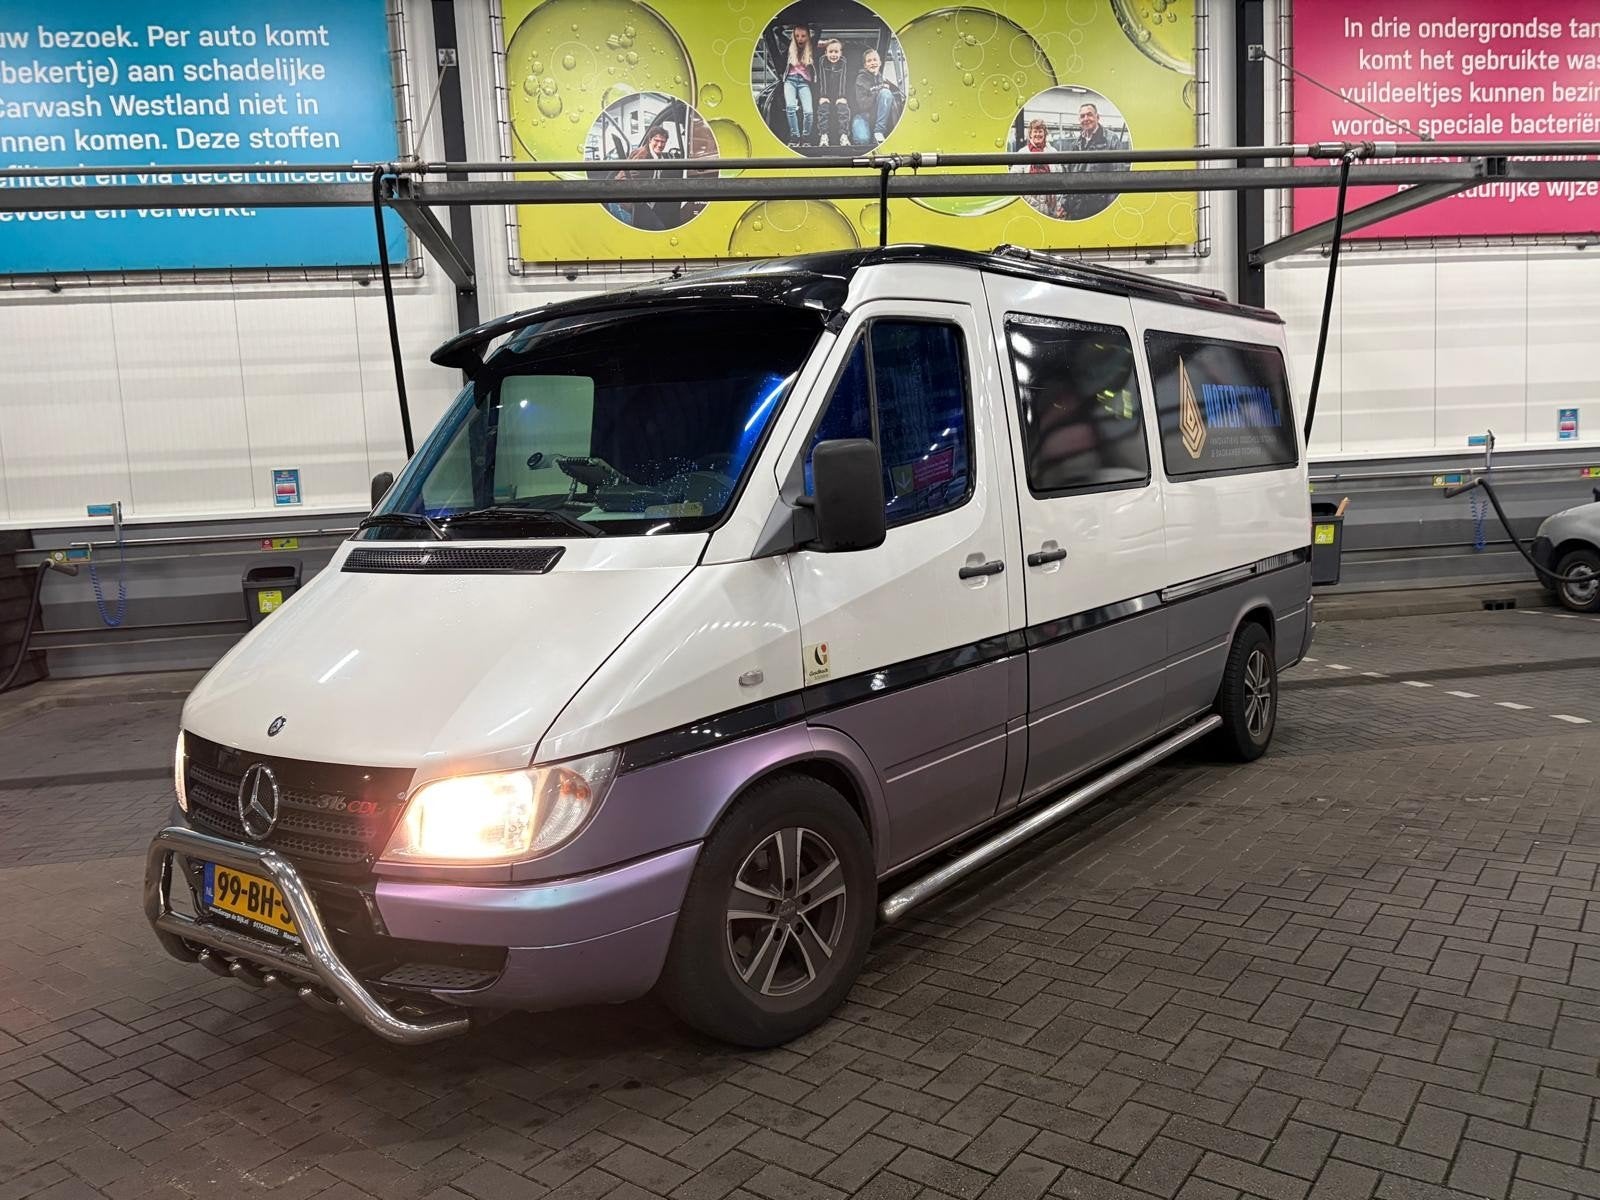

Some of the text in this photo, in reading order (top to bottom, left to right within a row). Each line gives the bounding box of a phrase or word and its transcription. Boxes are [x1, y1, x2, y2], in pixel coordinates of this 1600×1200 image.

[38, 25, 139, 48] bezoek.
[147, 25, 191, 47] Per
[199, 24, 256, 47] auto
[265, 24, 329, 46] komt
[1344, 17, 1362, 38] In
[1371, 17, 1410, 37] drie
[1418, 16, 1562, 43] ondergrondse
[128, 63, 174, 82] aan
[183, 58, 326, 86] schadelijke
[1359, 48, 1412, 70] komt
[1420, 49, 1454, 69] het
[1462, 48, 1559, 75] gebruikte
[109, 92, 229, 116] Westland
[239, 92, 288, 115] niet
[296, 92, 319, 115] in
[1340, 80, 1462, 107] vuildeeltjes
[1470, 81, 1545, 102] kunnen
[1, 126, 340, 152] nnen komen. Deze stoffen
[1332, 113, 1411, 136] worden
[1418, 113, 1503, 139] speciale
[1447, 180, 1599, 203] uurlijke wijze
